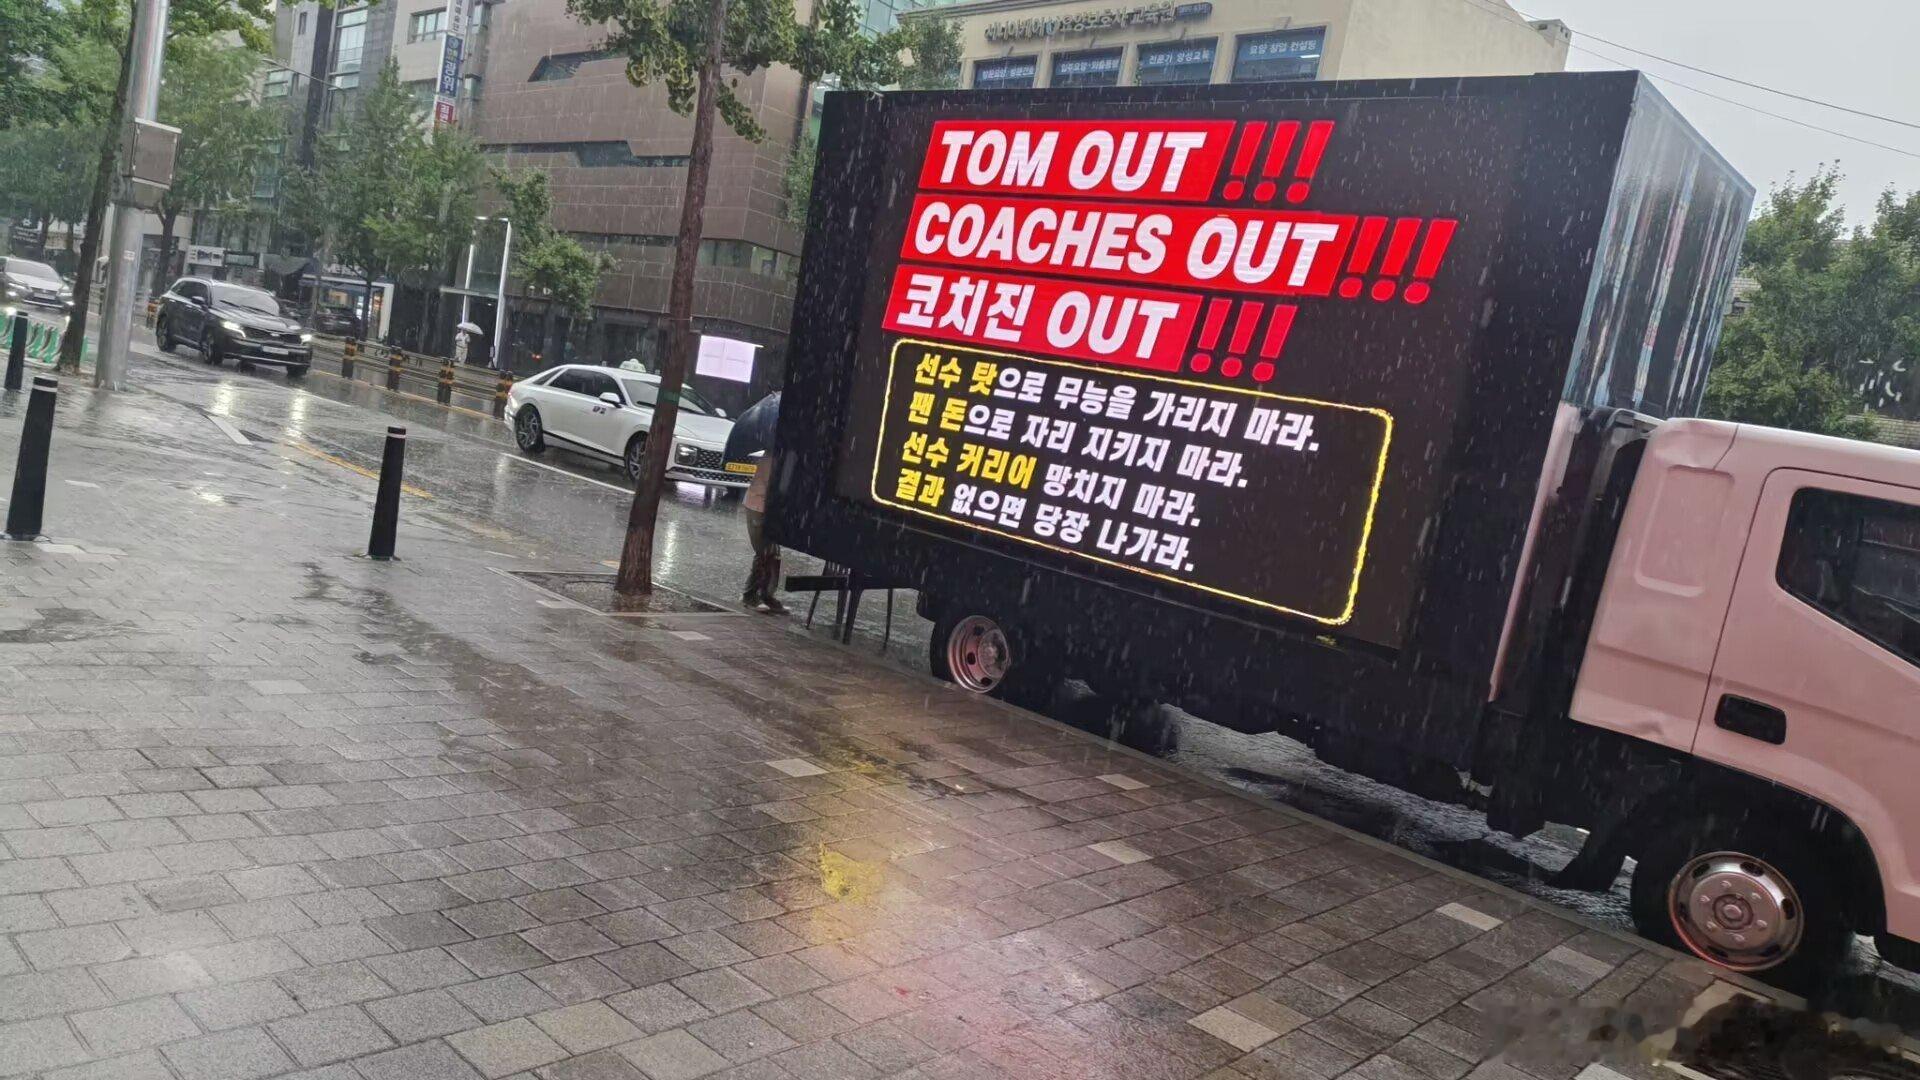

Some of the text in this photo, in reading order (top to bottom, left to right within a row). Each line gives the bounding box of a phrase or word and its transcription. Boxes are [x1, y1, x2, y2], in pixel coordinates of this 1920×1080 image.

[939, 129, 1057, 188] TOM
[1067, 130, 1207, 193] OUT
[914, 202, 1173, 274] COACHES
[1186, 216, 1340, 287] OUT
[896, 273, 1036, 343] 코치진
[1046, 290, 1181, 361] OUT
[914, 353, 1320, 452] 선수 탓으로 무능을 가리지 마라.
[939, 397, 1016, 441] 돈으로
[1020, 413, 1078, 454] 자리
[1080, 425, 1172, 473] 지키지
[1176, 443, 1249, 488] 마라.
[895, 467, 1195, 572] 결과 없으면 당장 나가라.
[901, 430, 1201, 527] 선수 커리어 망치지 마라.
